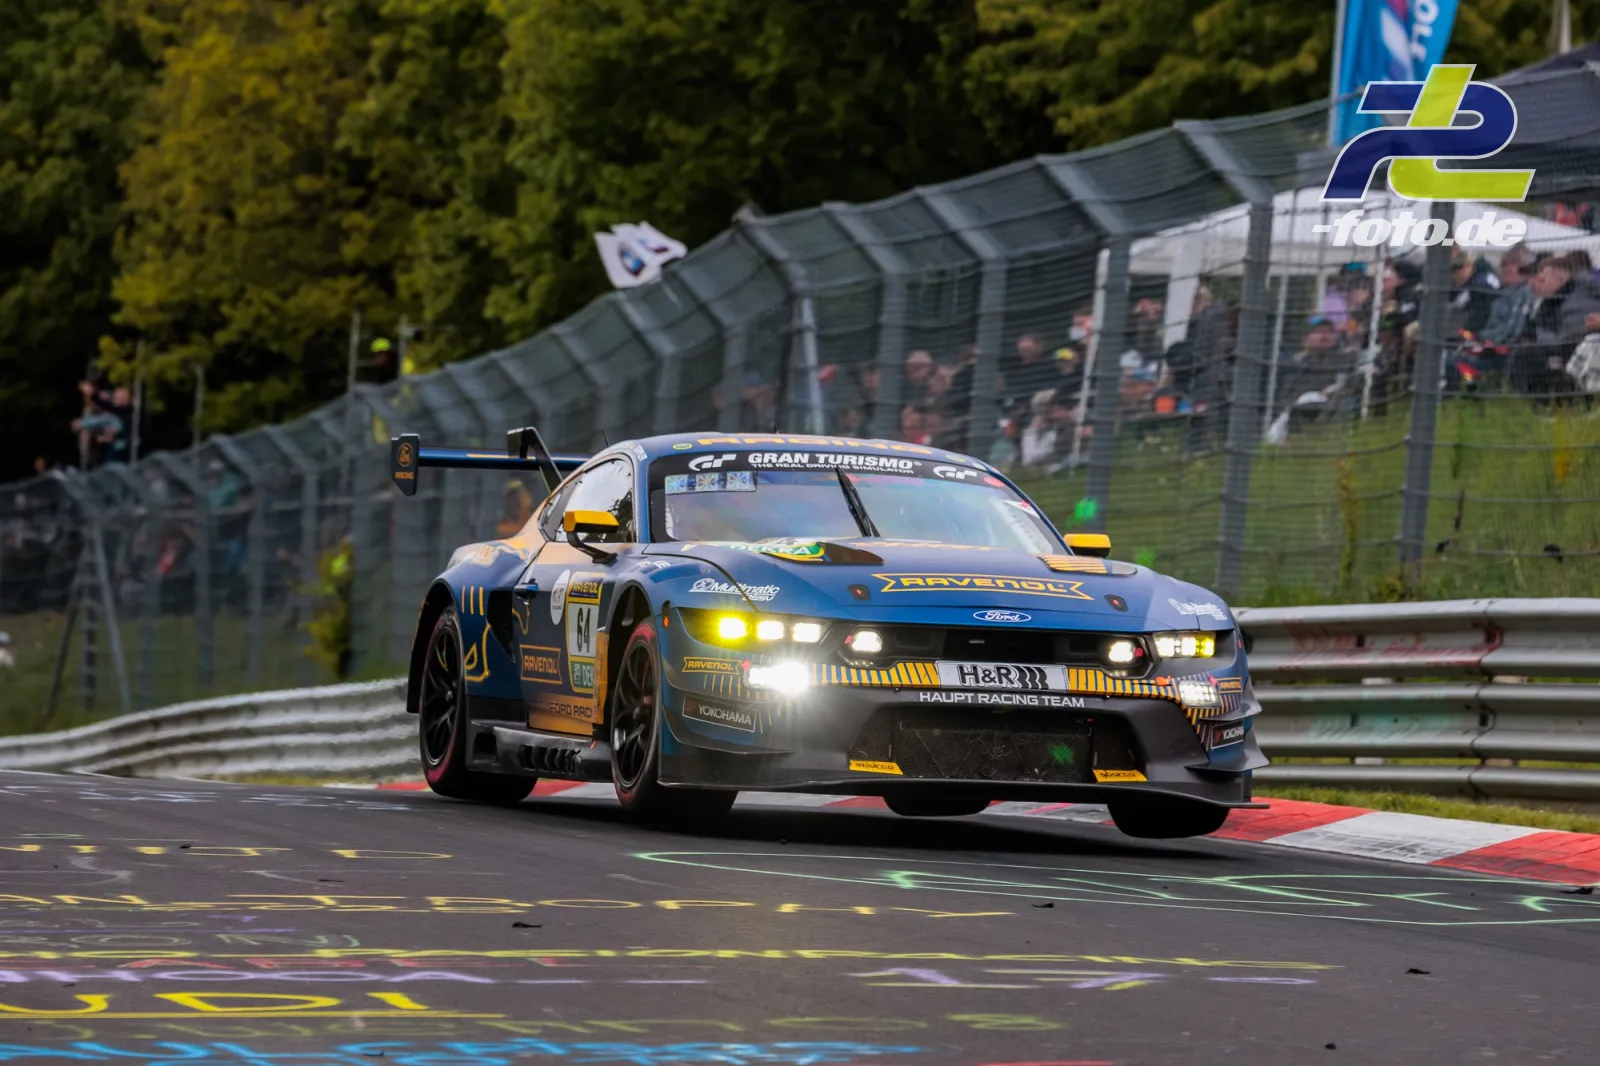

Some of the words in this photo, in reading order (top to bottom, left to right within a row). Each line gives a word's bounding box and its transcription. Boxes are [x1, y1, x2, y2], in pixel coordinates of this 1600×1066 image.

[747, 452, 807, 464] GRAN
[852, 465, 914, 474] SIMULATOR
[711, 582, 780, 595] Multimatic
[900, 577, 1067, 593] RAVENOL
[981, 610, 1023, 623] Ford
[576, 607, 591, 653] 64
[523, 655, 558, 673] RAVENOL
[687, 661, 734, 671] RAVENOL
[959, 665, 1018, 687] H&R
[919, 691, 974, 704] HAUPT
[979, 691, 1041, 706] RACING
[1043, 694, 1085, 708] TEAM
[550, 702, 573, 716] FORD
[698, 704, 752, 725] YOKOHAMA
